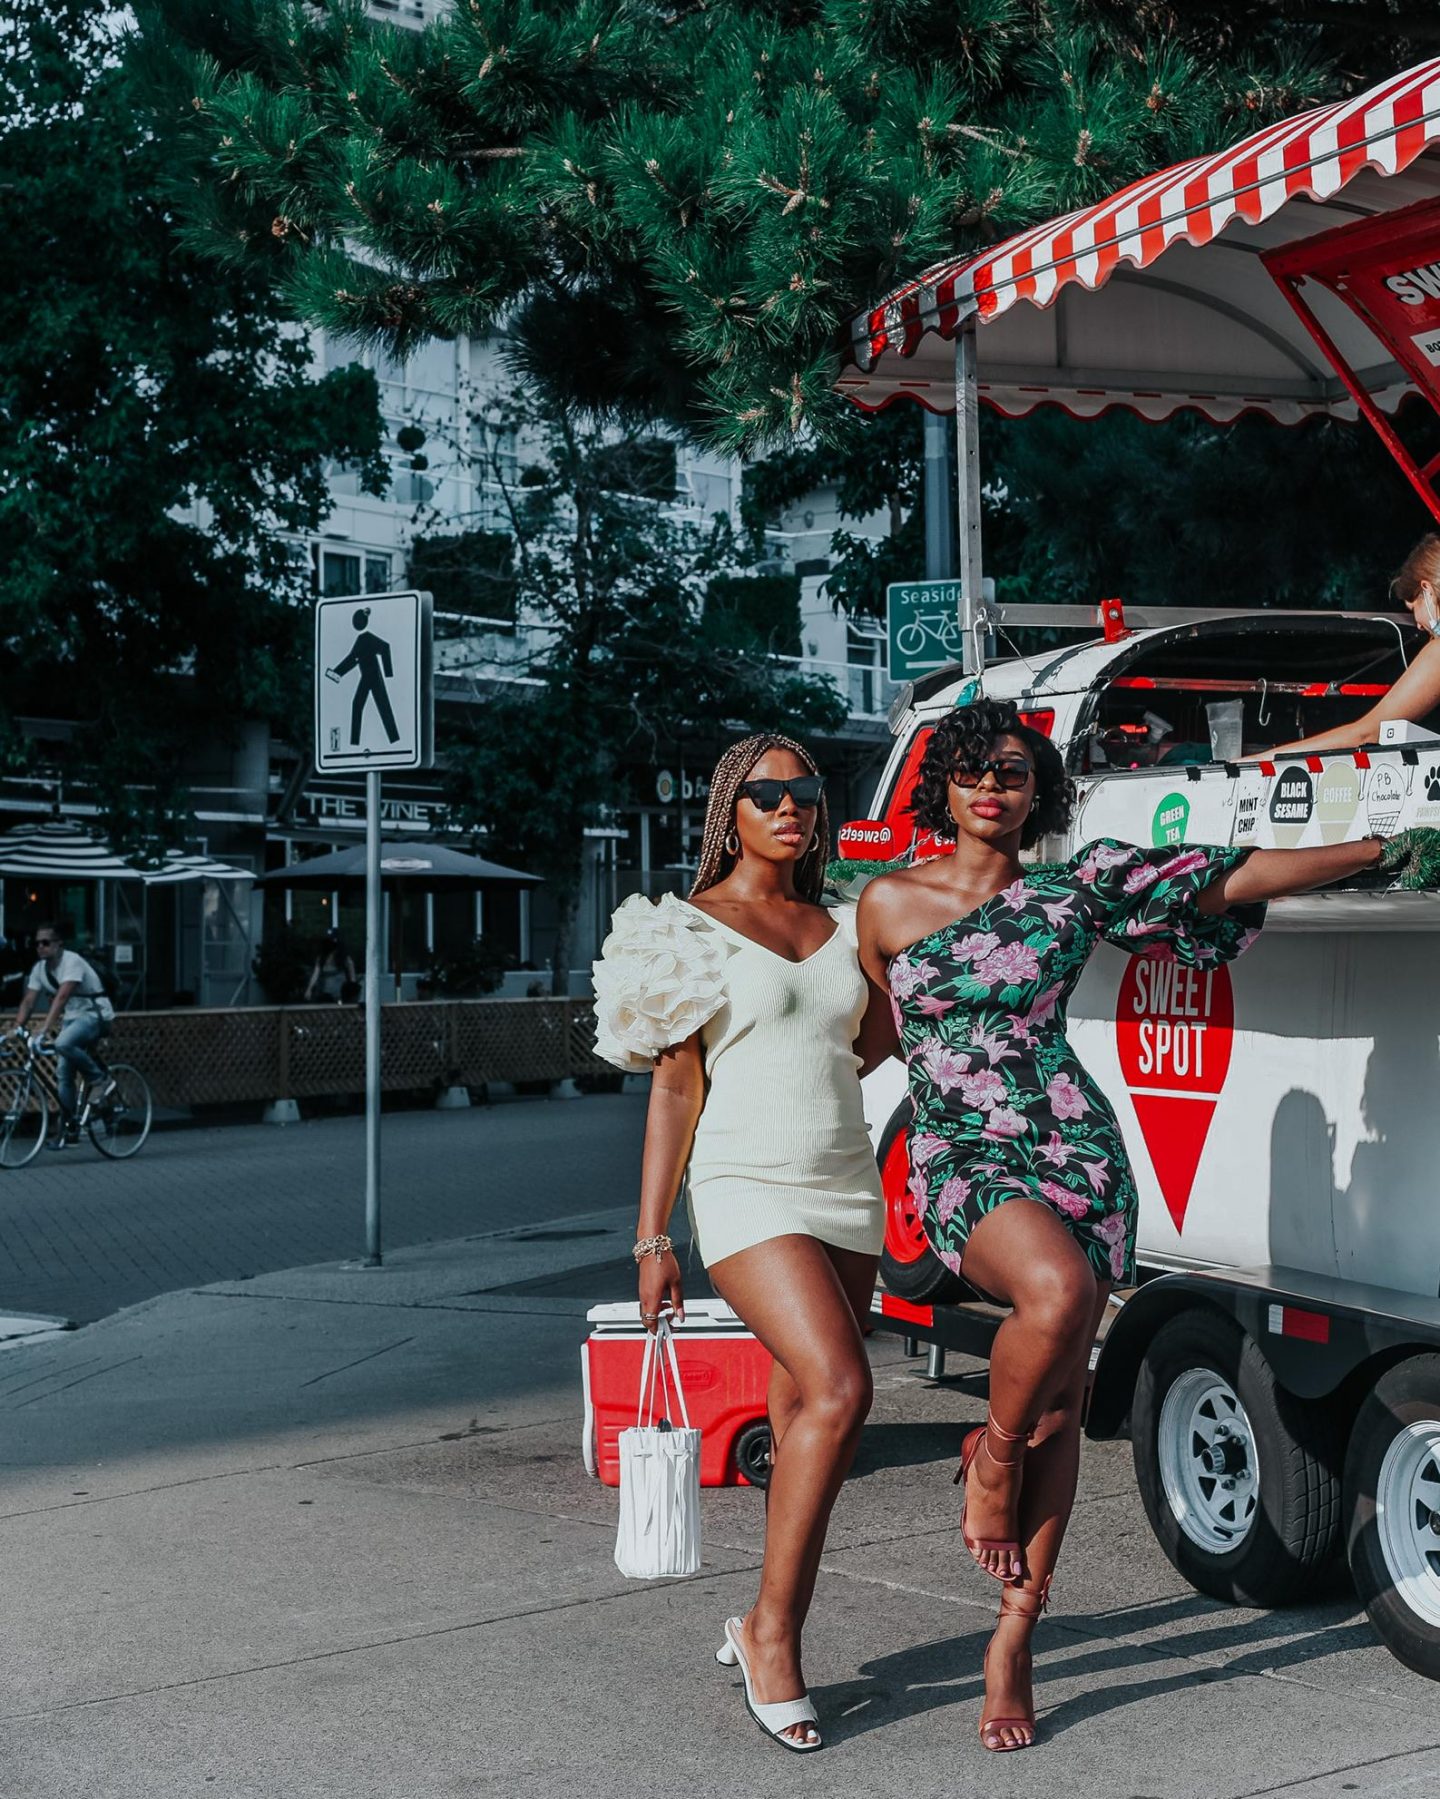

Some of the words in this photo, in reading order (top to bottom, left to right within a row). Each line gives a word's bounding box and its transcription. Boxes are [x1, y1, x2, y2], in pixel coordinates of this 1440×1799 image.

[1386, 262, 1440, 306] SW
[1281, 782, 1308, 799] BLACK
[1323, 787, 1352, 804] COFFEE
[306, 796, 357, 817] THE
[1239, 797, 1258, 812] MINT
[1274, 803, 1309, 819] SESAME
[1160, 805, 1185, 827] GREEN
[1238, 817, 1256, 833] CHIP
[1166, 827, 1181, 843] TEA
[1133, 959, 1216, 1017] SWEET
[1138, 1018, 1207, 1078] SPOT
